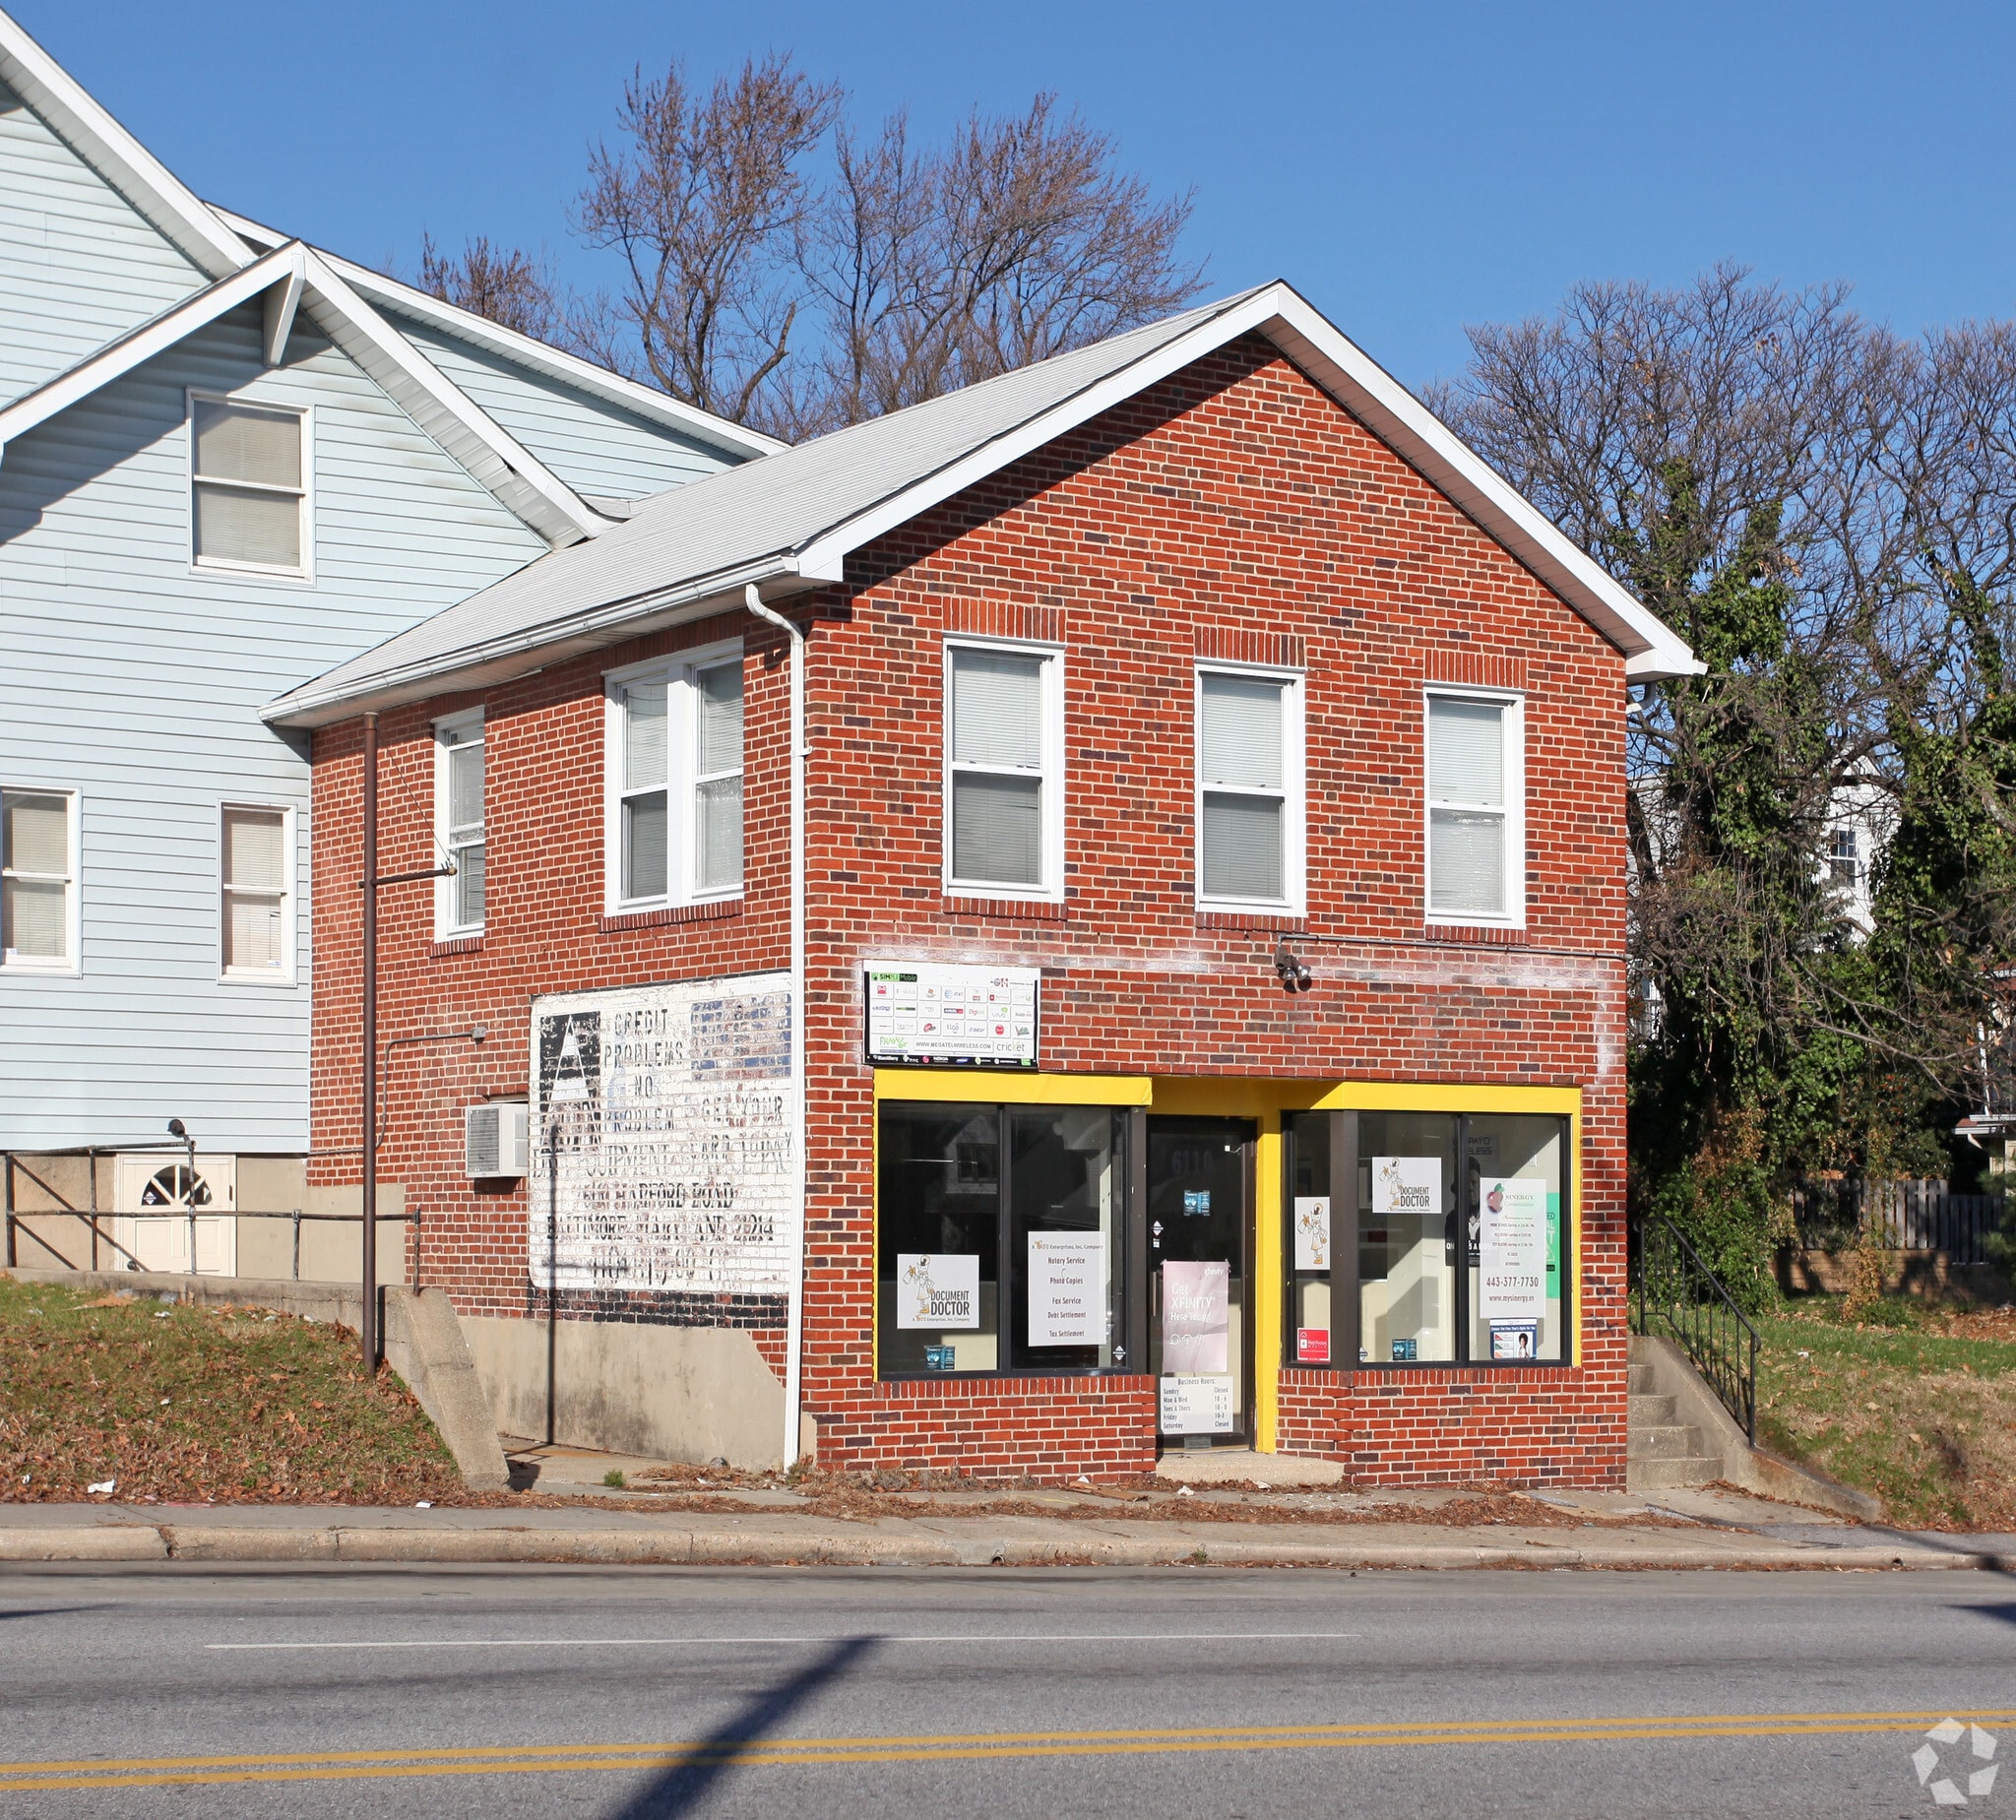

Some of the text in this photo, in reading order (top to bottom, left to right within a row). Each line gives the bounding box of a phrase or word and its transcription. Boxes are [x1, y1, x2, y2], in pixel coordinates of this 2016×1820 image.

[614, 1008, 668, 1036] CREDIT
[996, 1040, 1026, 1052] cricket
[604, 1040, 684, 1069] PROBLEMS
[634, 1075, 654, 1098] NO
[604, 1107, 675, 1132] PROBLEM
[691, 1183, 734, 1209] ROAD
[1401, 1186, 1429, 1195] DOCUMENT
[1401, 1196, 1430, 1207] DOCTOR
[1486, 1277, 1539, 1287] 443-377-7730
[1171, 1282, 1189, 1295] Get
[930, 1290, 970, 1301] DOCUMENT
[1488, 1294, 1535, 1303] www.mysinergy.us
[930, 1301, 971, 1316] DOCTOR
[1170, 1311, 1188, 1321] Here
